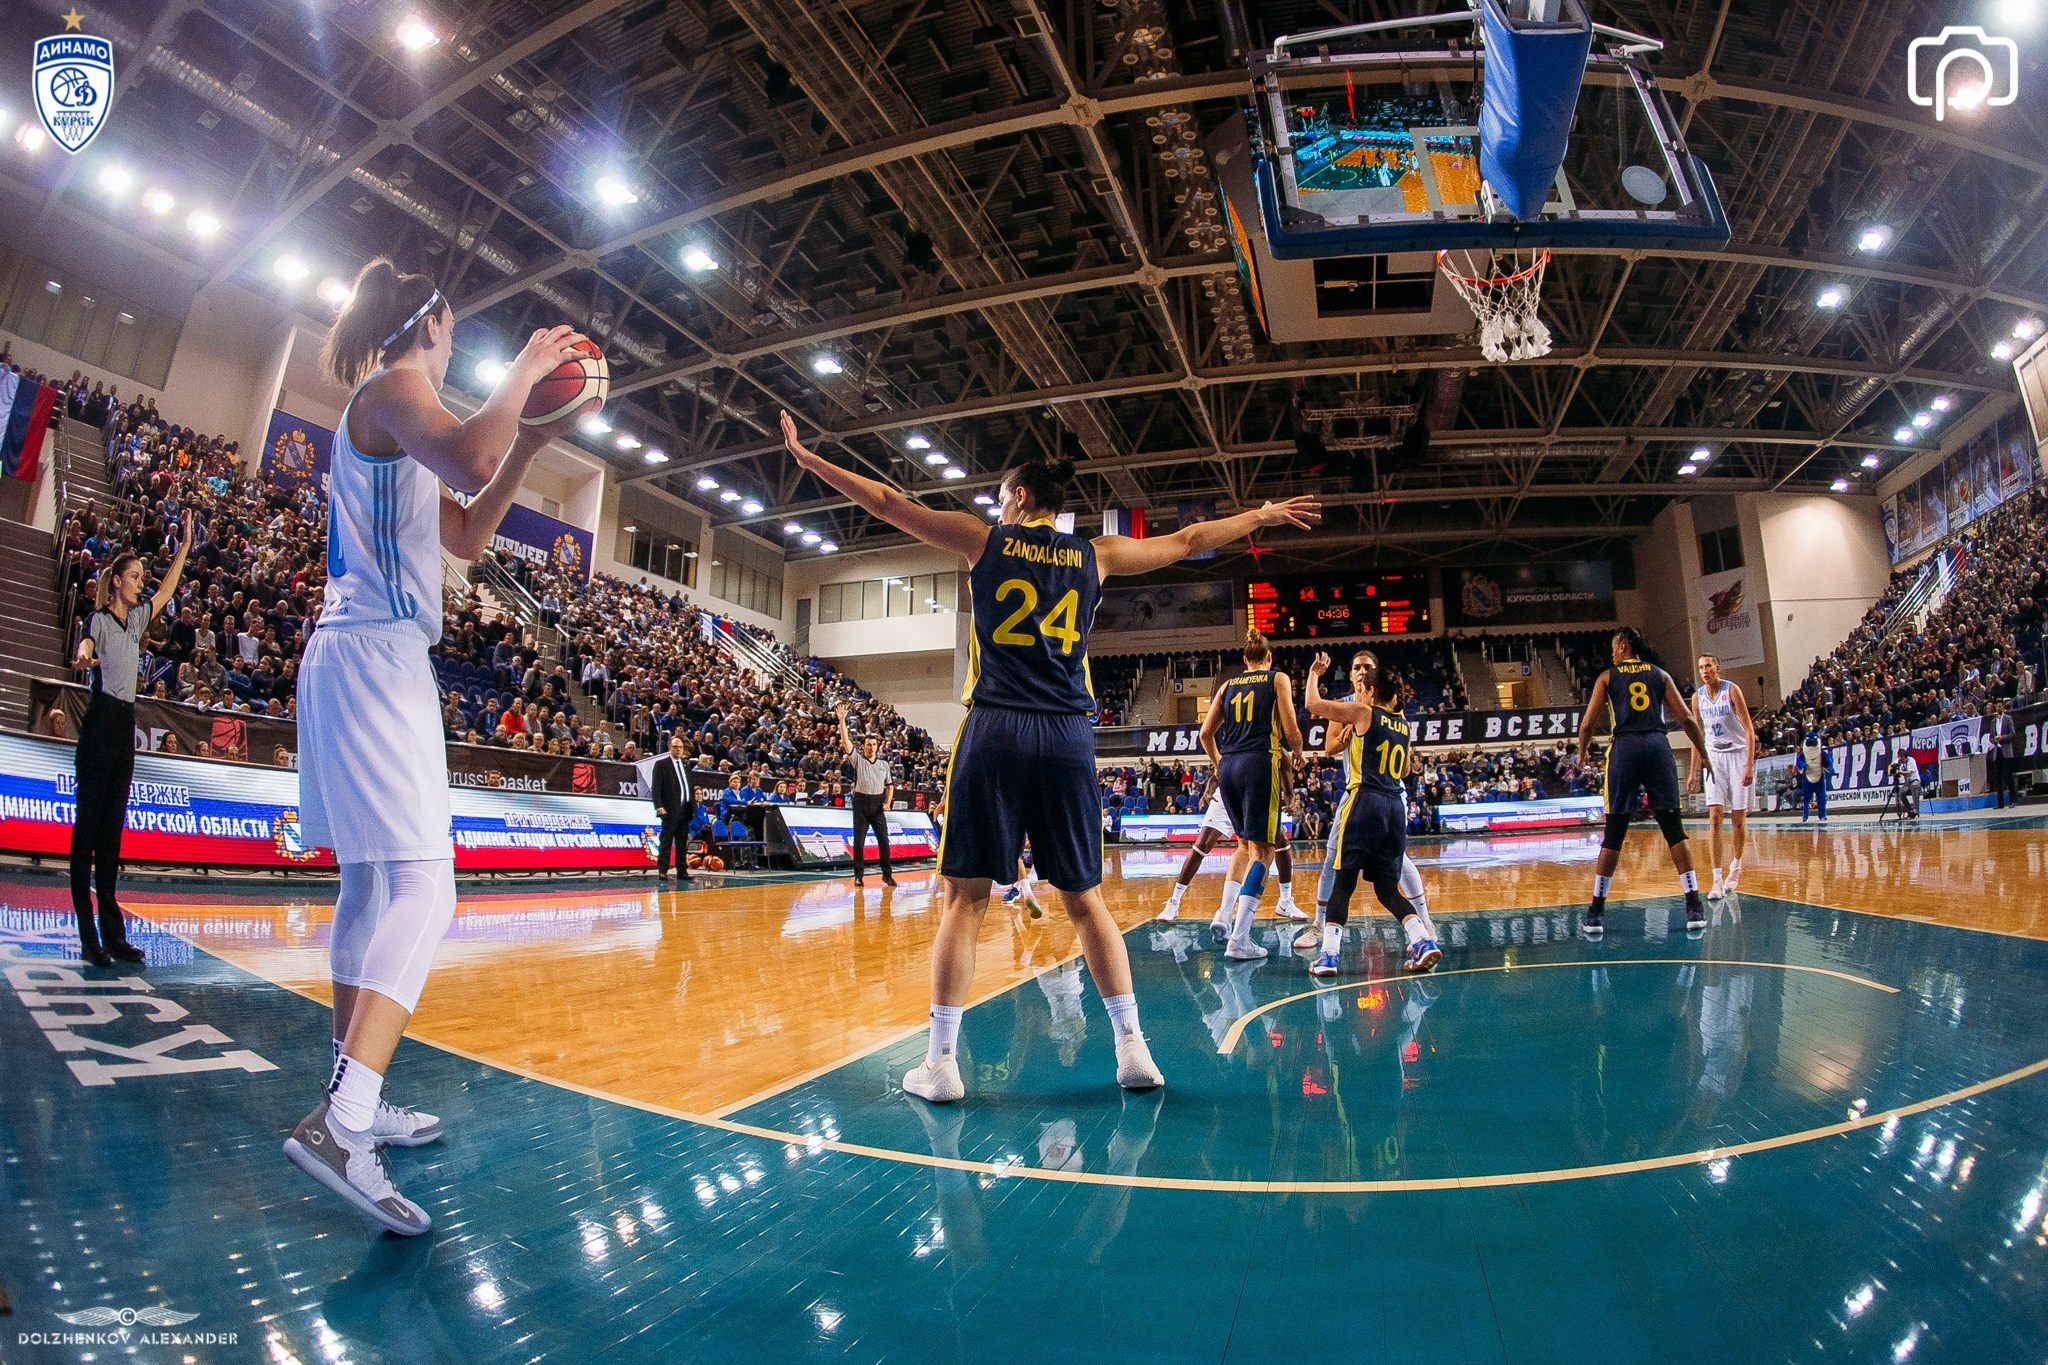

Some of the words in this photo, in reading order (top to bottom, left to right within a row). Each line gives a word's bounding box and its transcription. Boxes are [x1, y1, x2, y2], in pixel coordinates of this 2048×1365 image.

[1002, 537, 1083, 568] ZANDALASINI
[1506, 592, 1550, 603] КУРСКОЙ
[1552, 592, 1595, 601] ОБЛАСТИ
[992, 579, 1081, 656] 24
[1317, 608, 1350, 619] 04:36
[1617, 663, 1652, 673] VAUGHN
[1175, 683, 1183, 693] D
[1628, 681, 1650, 711] 8
[1230, 690, 1255, 723] 11
[1147, 730, 1199, 752] МЫ
[1485, 713, 1580, 738] ВСЕХ!
[1380, 715, 1408, 736] PLUM
[1711, 722, 1724, 737] 12
[1376, 740, 1406, 779] 10
[1828, 791, 1861, 802] изической
[127, 810, 198, 834] КУРСКОЙ
[201, 815, 270, 839] ОБЛАСТИ
